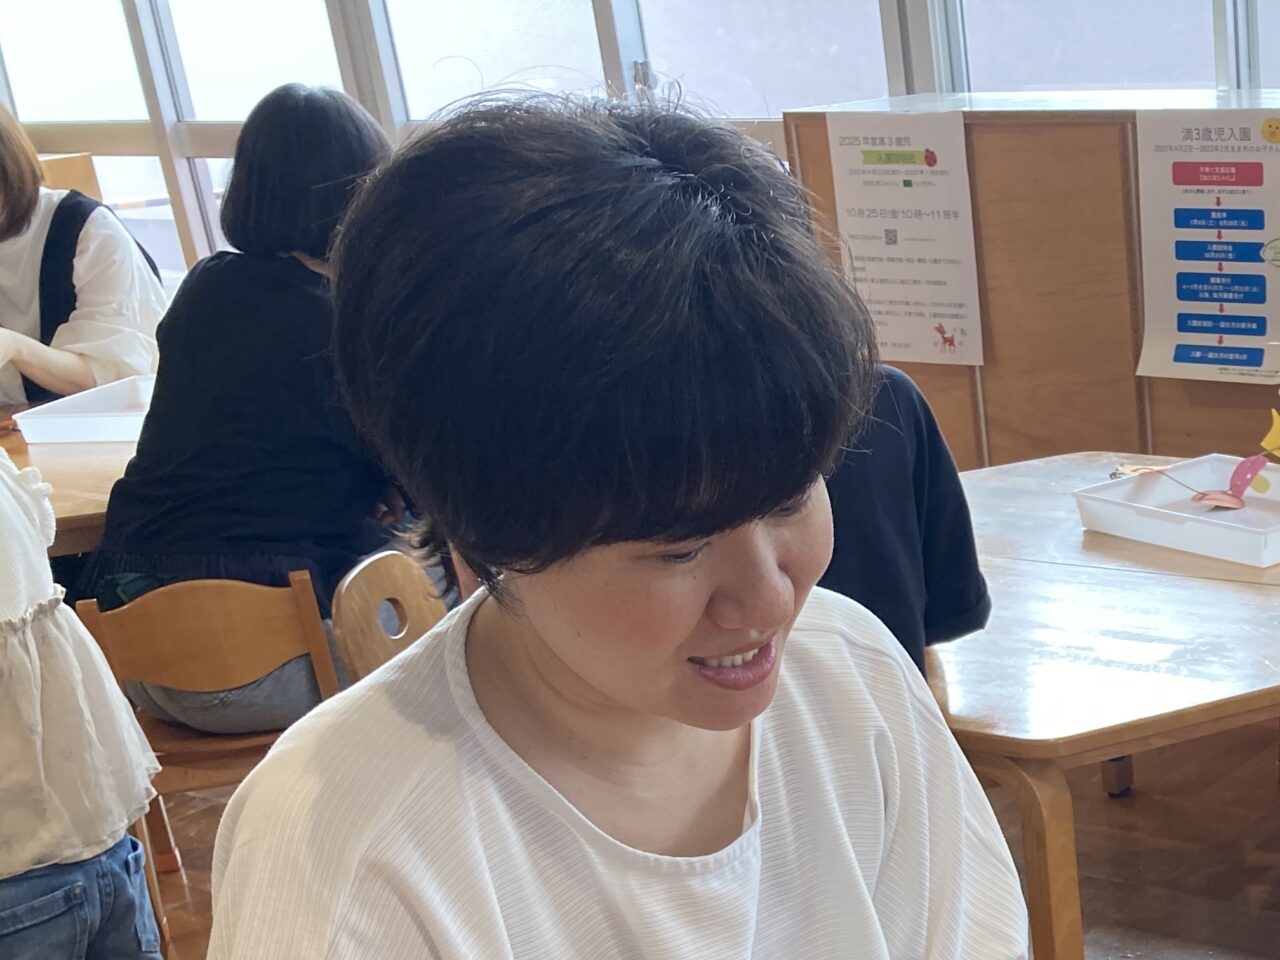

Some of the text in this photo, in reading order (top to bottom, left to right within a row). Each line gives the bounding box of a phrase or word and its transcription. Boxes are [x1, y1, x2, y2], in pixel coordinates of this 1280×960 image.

[1182, 127, 1252, 142] 満3歳児入園
